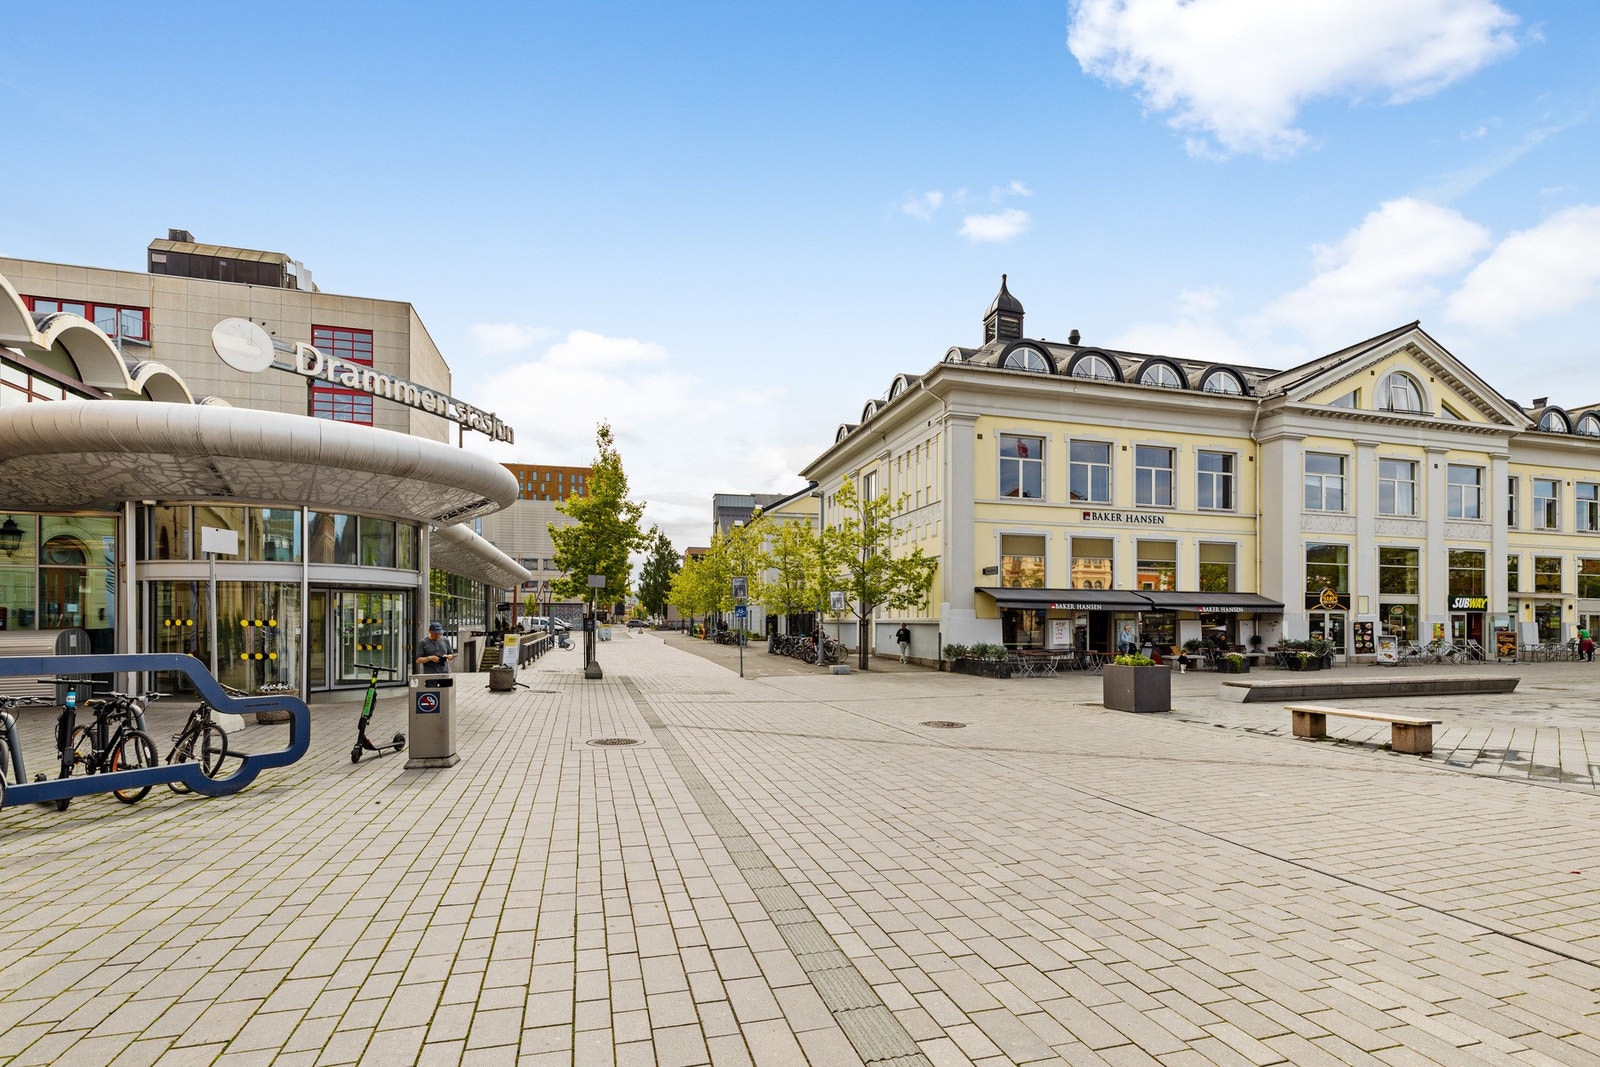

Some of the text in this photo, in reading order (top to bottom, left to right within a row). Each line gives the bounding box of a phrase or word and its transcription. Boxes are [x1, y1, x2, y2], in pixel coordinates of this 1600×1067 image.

[295, 341, 515, 444] Drammen stasjon
[1091, 511, 1165, 524] BAKER HANSEN
[1452, 597, 1489, 609] SUBWAY
